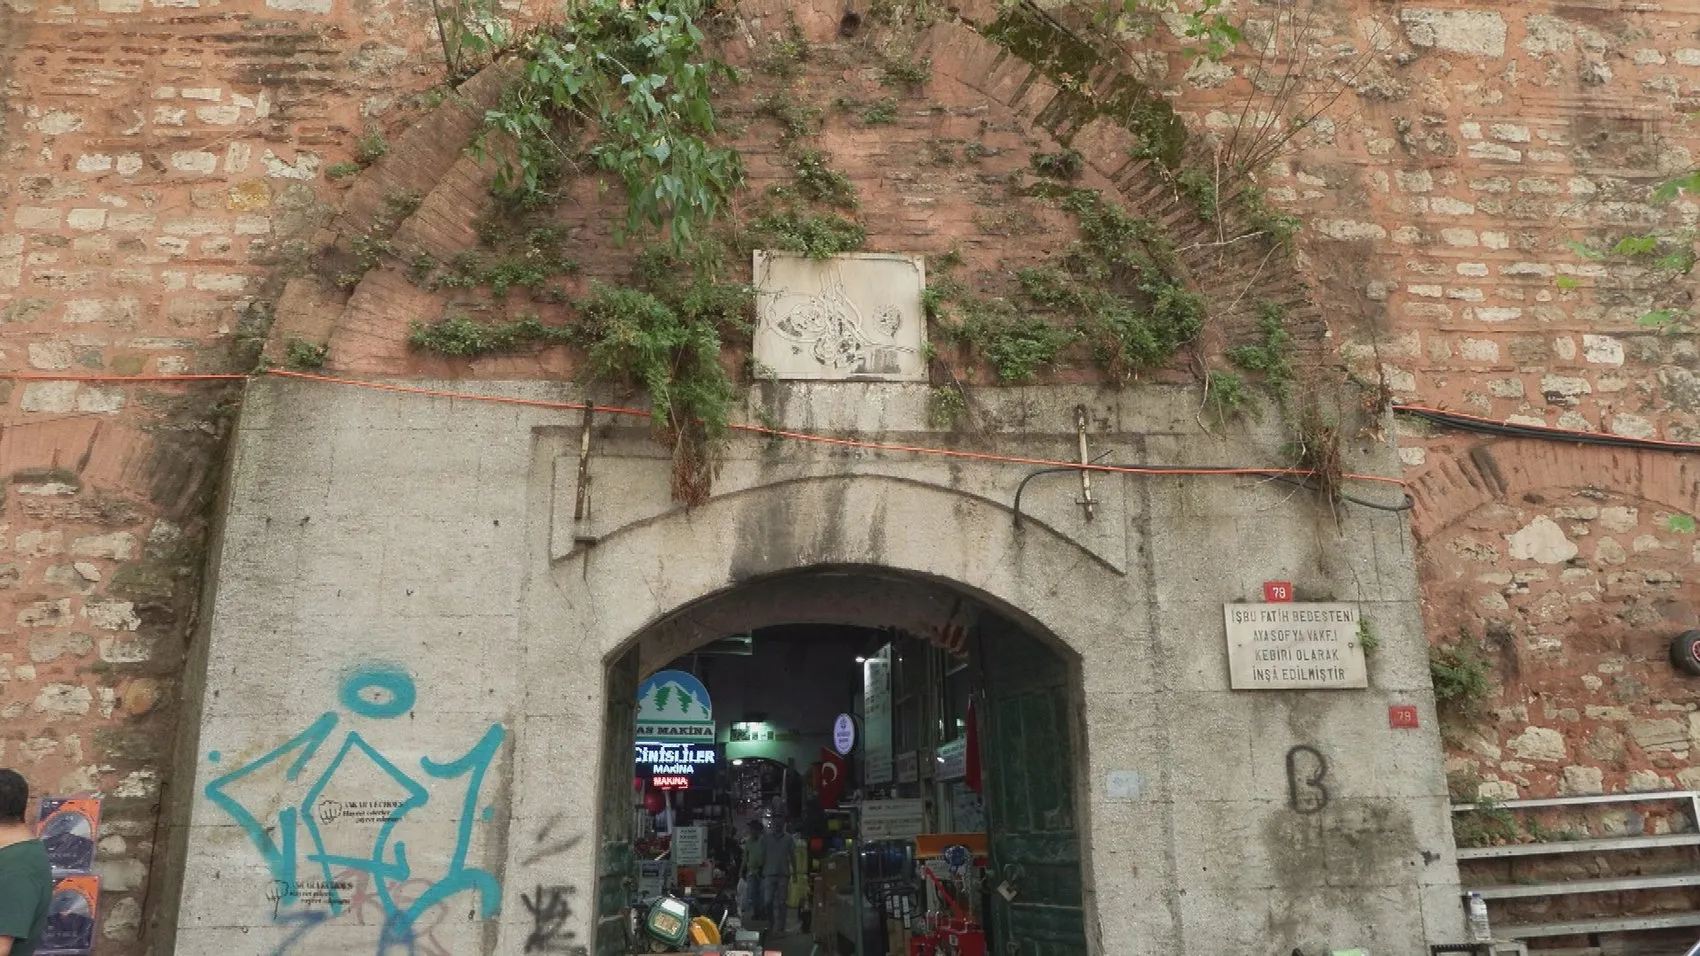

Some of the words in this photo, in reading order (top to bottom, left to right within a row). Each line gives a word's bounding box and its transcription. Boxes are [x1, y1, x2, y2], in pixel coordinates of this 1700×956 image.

[1272, 587, 1286, 599] 79
[1260, 608, 1289, 622] FATİH
[1253, 629, 1305, 642] AYASOFYA
[1295, 648, 1340, 661] OLARAK
[1281, 665, 1345, 682] EDİLMİŞTİR
[657, 726, 713, 736] MAKİNA
[653, 763, 695, 775] MAKİNA
